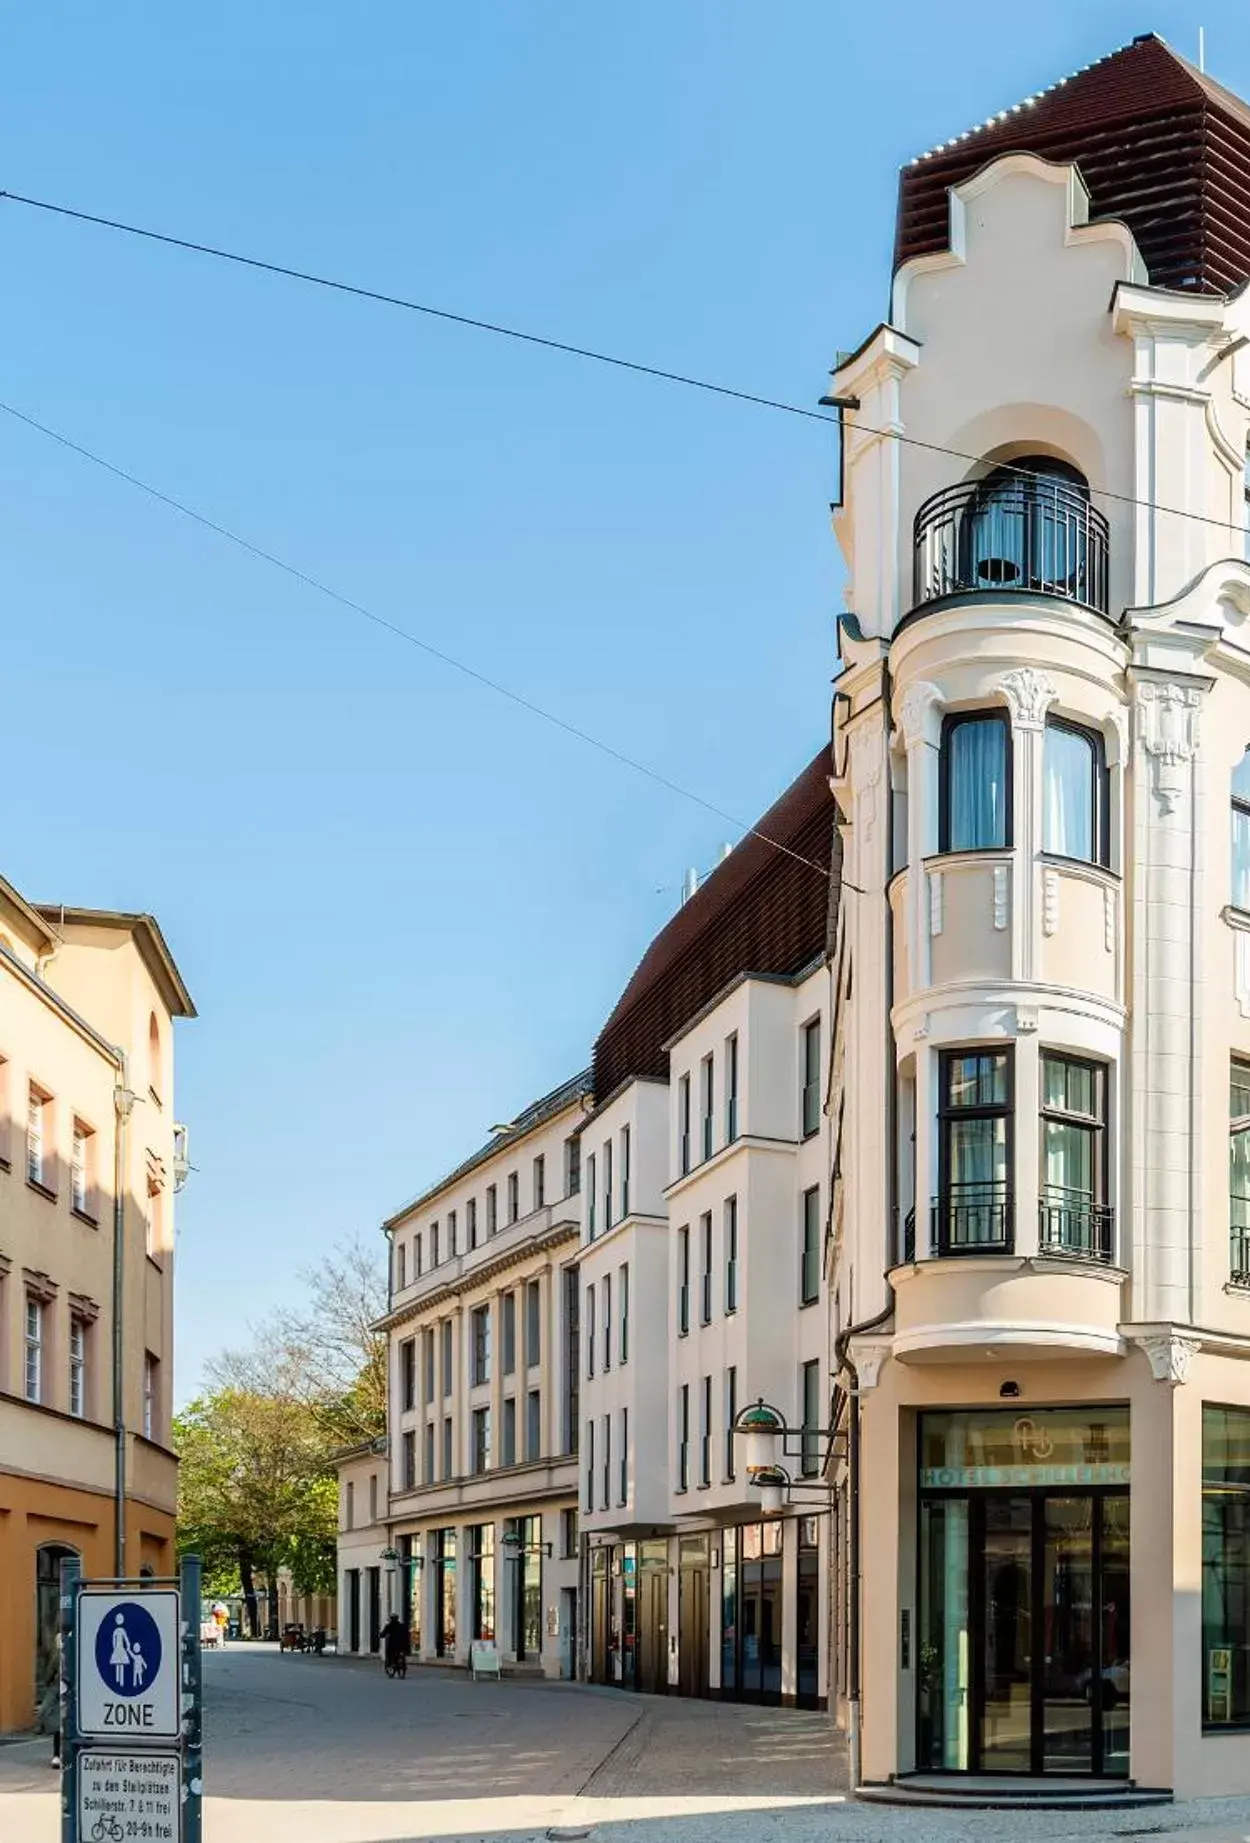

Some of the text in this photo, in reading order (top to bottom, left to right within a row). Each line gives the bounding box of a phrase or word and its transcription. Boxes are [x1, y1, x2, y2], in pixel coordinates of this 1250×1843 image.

[922, 1468, 989, 1485] HOTEL
[103, 1703, 154, 1726] ZONE
[84, 1757, 175, 1777] Zufahrt für Berechtigte
[92, 1780, 101, 1792] zu
[105, 1779, 119, 1792] den
[156, 1801, 171, 1816] frei
[156, 1822, 173, 1839] frei
